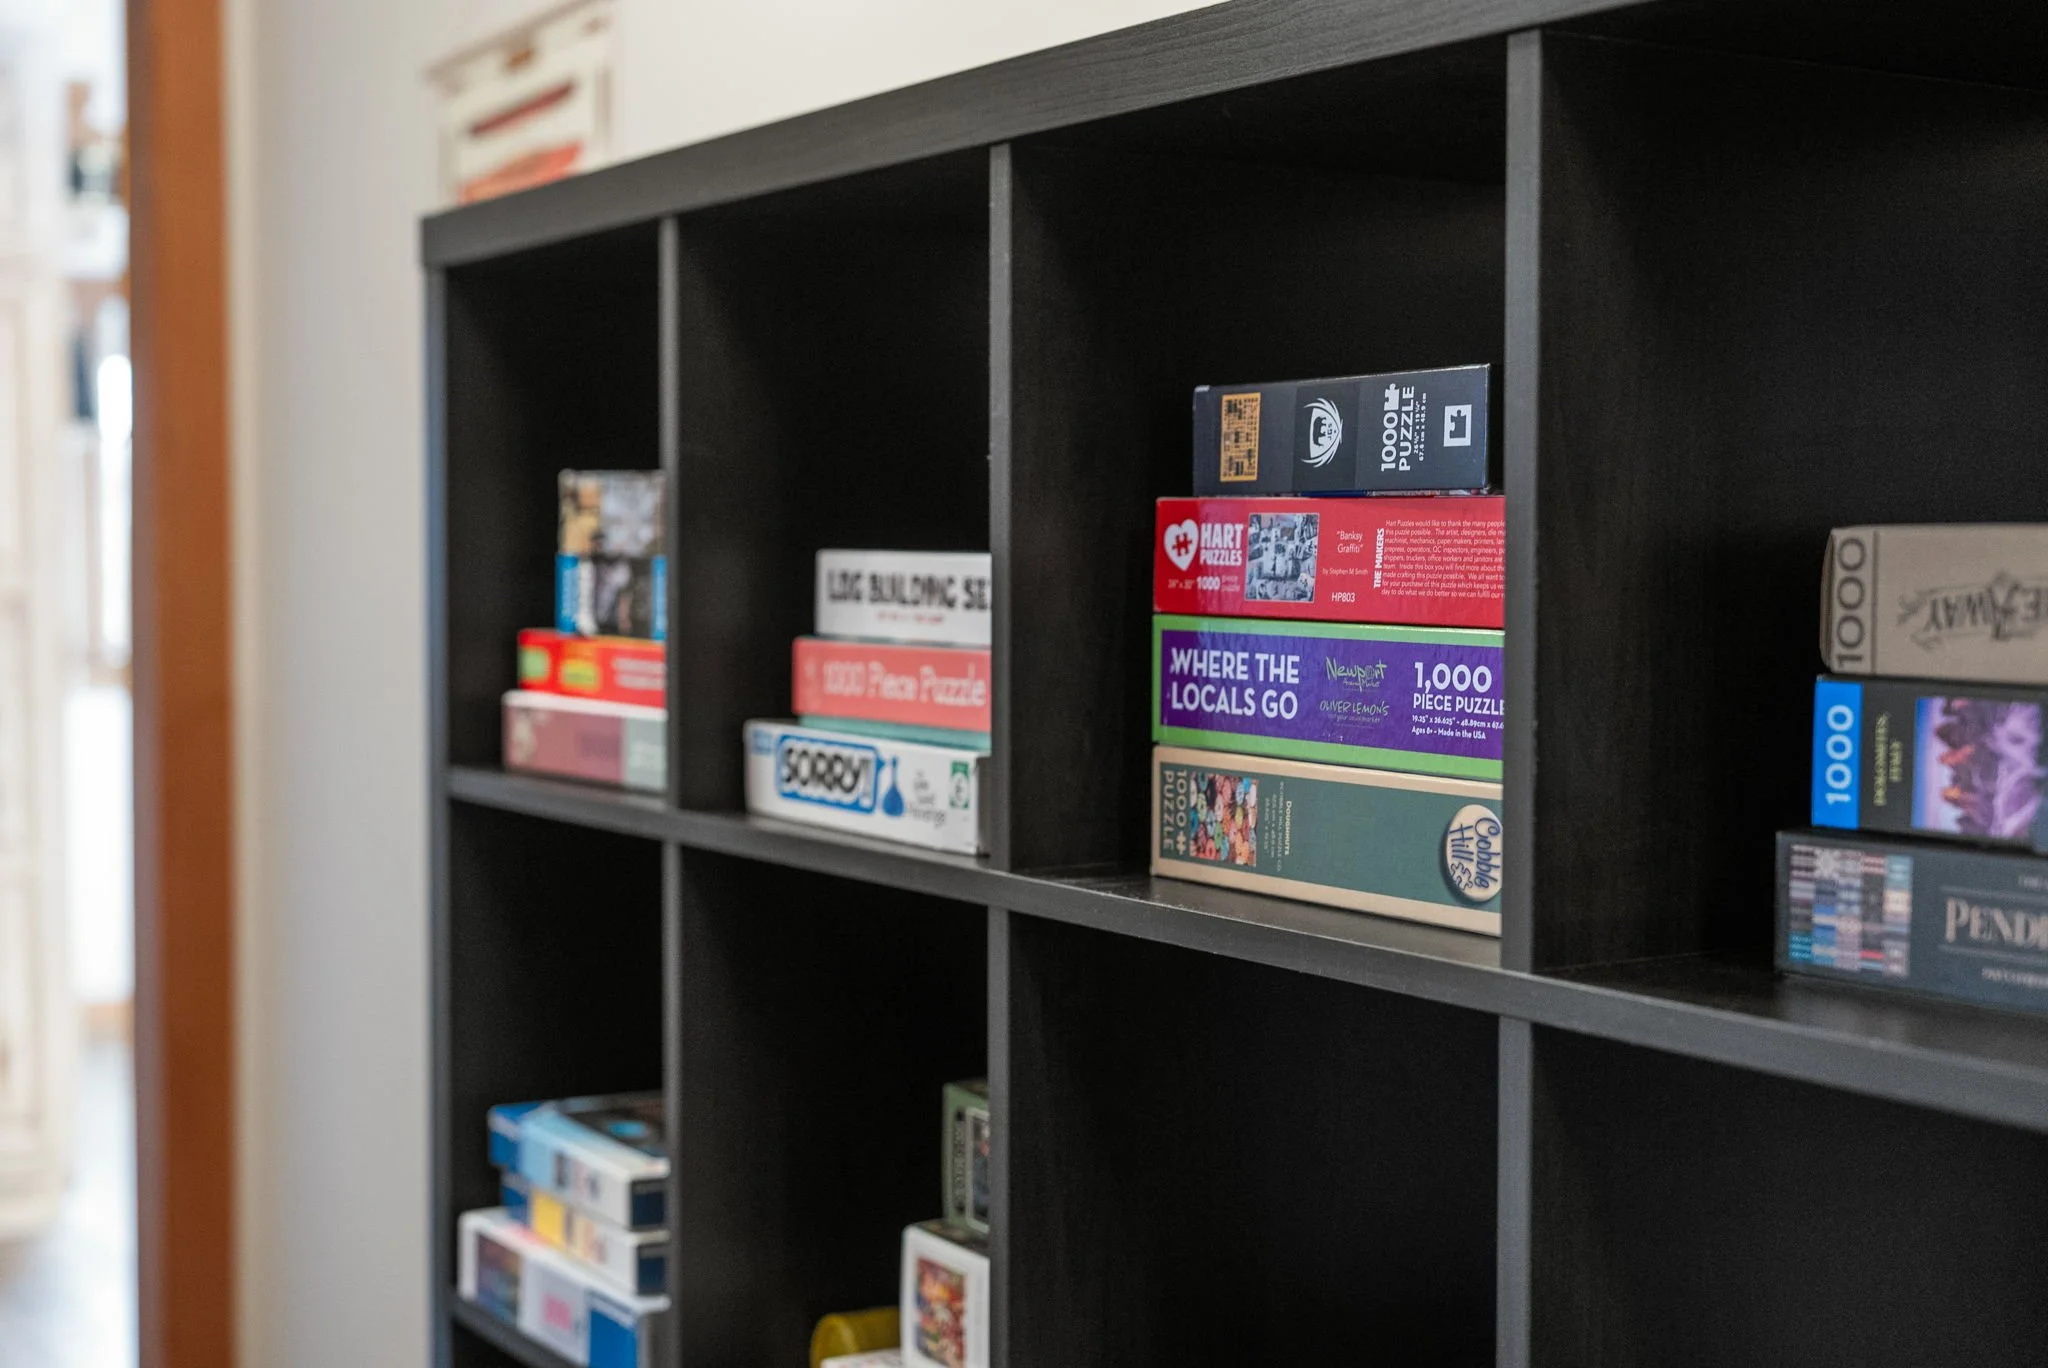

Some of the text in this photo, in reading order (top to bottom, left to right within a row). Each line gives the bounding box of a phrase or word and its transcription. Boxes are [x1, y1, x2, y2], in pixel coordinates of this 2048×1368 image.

[1381, 412, 1398, 472] 1000
[1399, 386, 1415, 471] PUZZLE
[1201, 523, 1244, 549] HART
[1394, 529, 1410, 537] puzzle
[1200, 549, 1242, 566] PUZZLES
[1374, 528, 1385, 589] THE MAKERS
[1428, 554, 1442, 562] office
[1455, 563, 1465, 571] find
[868, 570, 957, 610] BUILDING
[1196, 576, 1221, 590] 1000
[1390, 581, 1400, 589] your
[1402, 580, 1423, 588] purchase
[1424, 579, 1430, 588] of
[1431, 580, 1440, 588] this
[1441, 581, 1456, 589] puzzle
[1474, 581, 1489, 590] keeps
[1426, 572, 1442, 580] puzzle
[1434, 589, 1450, 597] better
[1332, 592, 1356, 603] HP803
[1836, 537, 1866, 668] 1000
[823, 660, 986, 706] 1000 Piece Puzzle
[1171, 647, 1300, 684] WHERE THE
[1326, 656, 1387, 692] Newport
[1414, 661, 1492, 694] 1,000
[1172, 681, 1298, 720] LOCALS GO
[1320, 700, 1351, 713] OLIVER
[1352, 700, 1389, 716] LEMON'S
[1413, 693, 1505, 716] PIECE PUZZLE
[1412, 726, 1425, 735] Ages
[1438, 728, 1454, 737] Made
[1455, 729, 1461, 737] in
[1462, 729, 1472, 739] the
[1473, 730, 1487, 740] USA
[1825, 704, 1854, 805] 1000
[781, 746, 872, 806] SORRY!
[1163, 771, 1175, 850] PUZZLE
[1176, 770, 1187, 827] 1000
[1448, 824, 1474, 861] Hill
[1473, 817, 1501, 888] Cobble
